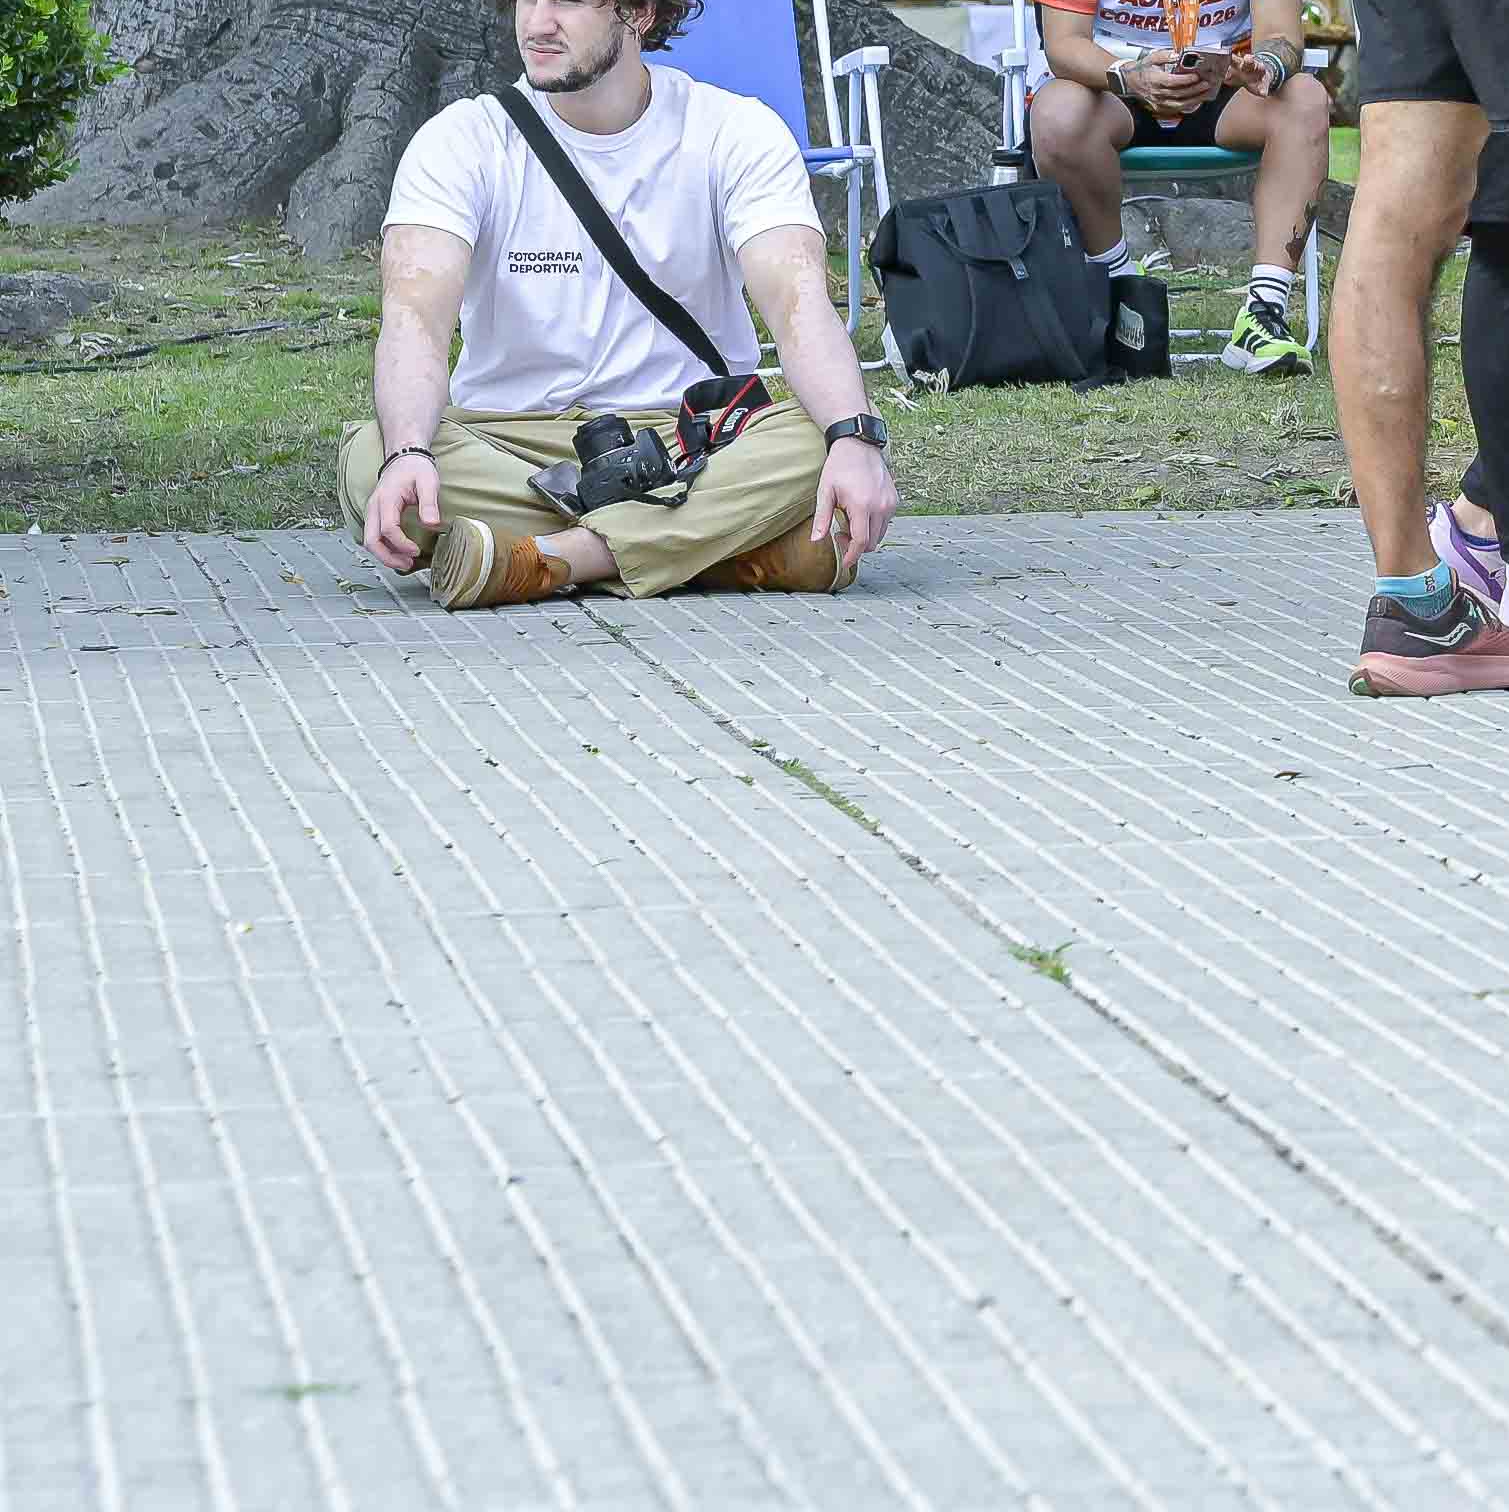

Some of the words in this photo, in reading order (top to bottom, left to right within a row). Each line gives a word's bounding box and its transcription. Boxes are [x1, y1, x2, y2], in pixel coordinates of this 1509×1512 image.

[1198, 4, 1236, 28] 026
[507, 251, 583, 262] FOTOGRAFIA
[509, 263, 580, 274] DEPORTIVA
